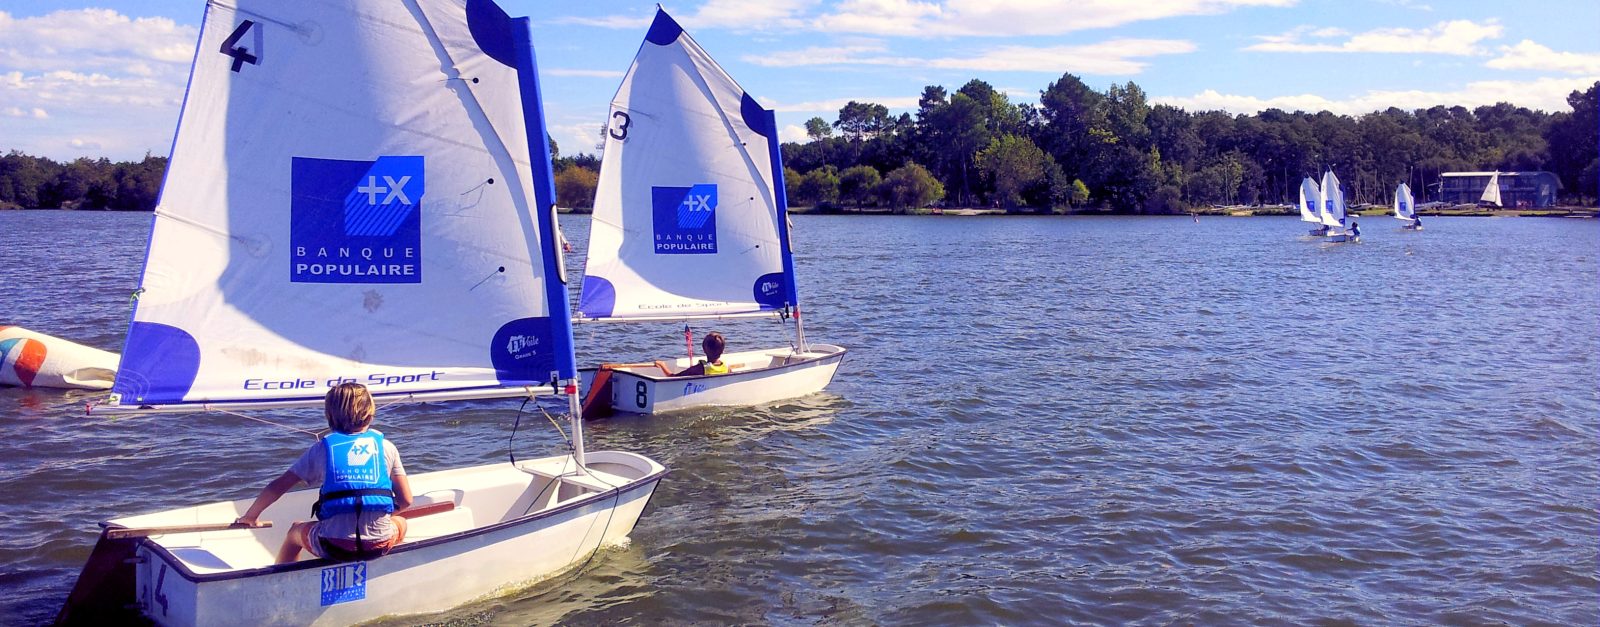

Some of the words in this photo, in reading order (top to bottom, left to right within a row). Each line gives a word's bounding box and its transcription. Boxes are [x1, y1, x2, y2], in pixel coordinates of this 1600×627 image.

[219, 19, 263, 73] 4
[610, 111, 630, 140] 3
[296, 246, 413, 260] BANQUE
[296, 263, 415, 276] POPULAIRE
[243, 378, 315, 391] Ecole
[367, 370, 445, 387] Sport
[636, 380, 648, 409] 8
[154, 563, 169, 617] 4
